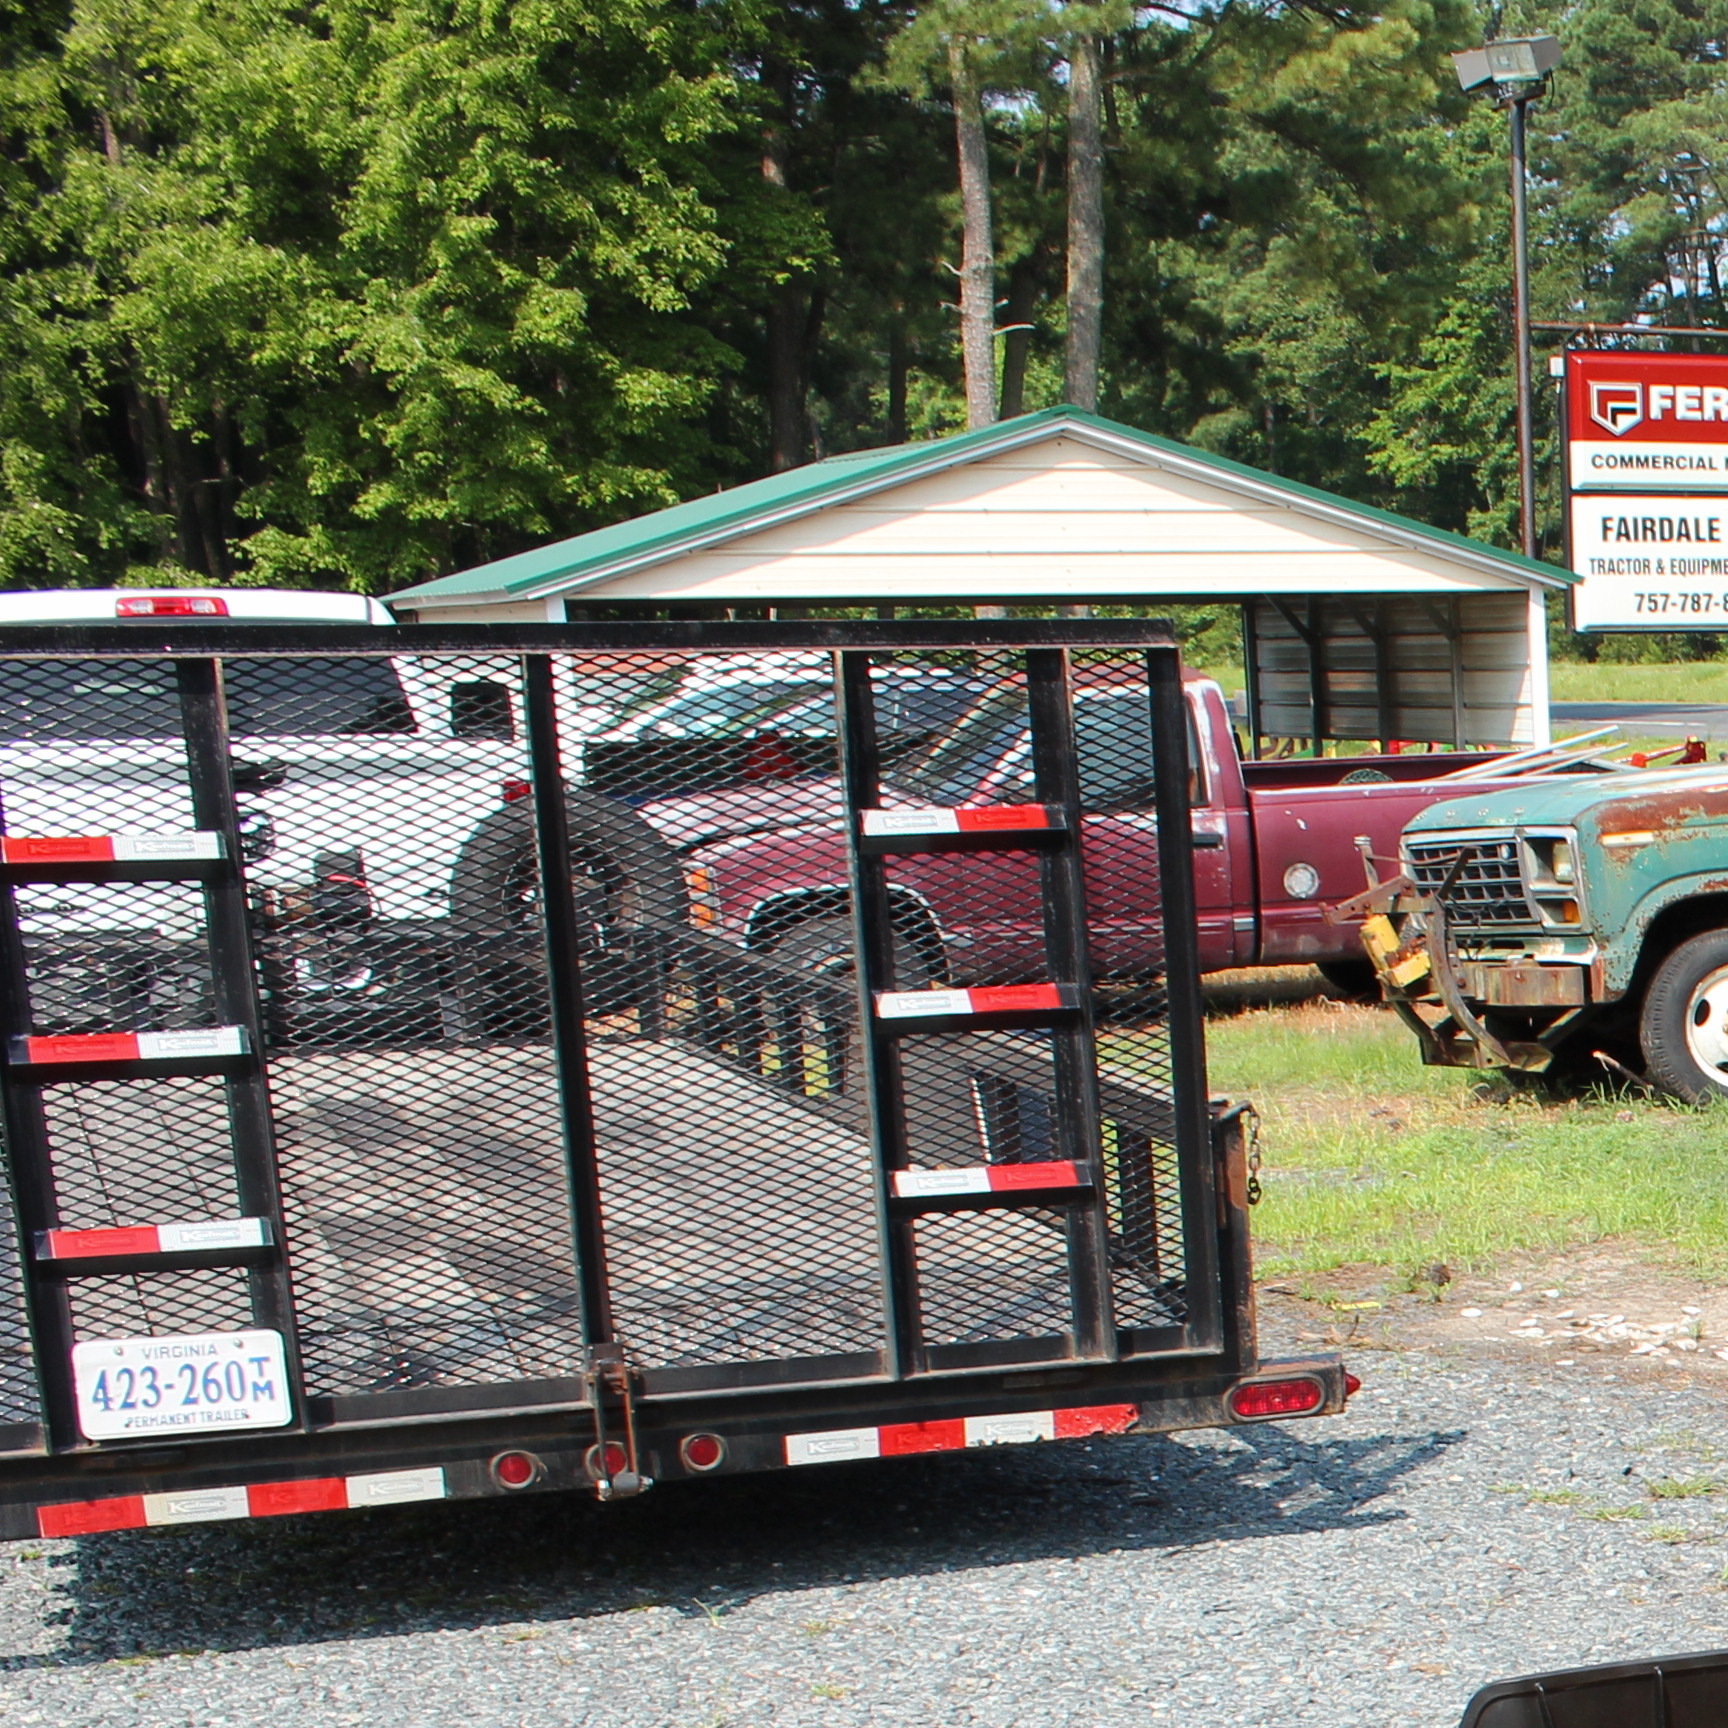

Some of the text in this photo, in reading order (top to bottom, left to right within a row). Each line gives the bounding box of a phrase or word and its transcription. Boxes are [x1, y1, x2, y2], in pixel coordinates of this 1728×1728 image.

[1591, 454, 1718, 471] COMMERCIAL
[1601, 517, 1721, 543] FAIRDALE
[1590, 558, 1651, 575] TRACTOR
[1656, 558, 1665, 574] &
[142, 1343, 218, 1359] VIRGINIA
[91, 1359, 246, 1412] 423-260
[126, 1408, 249, 1429] PERMANENT TRAILER
